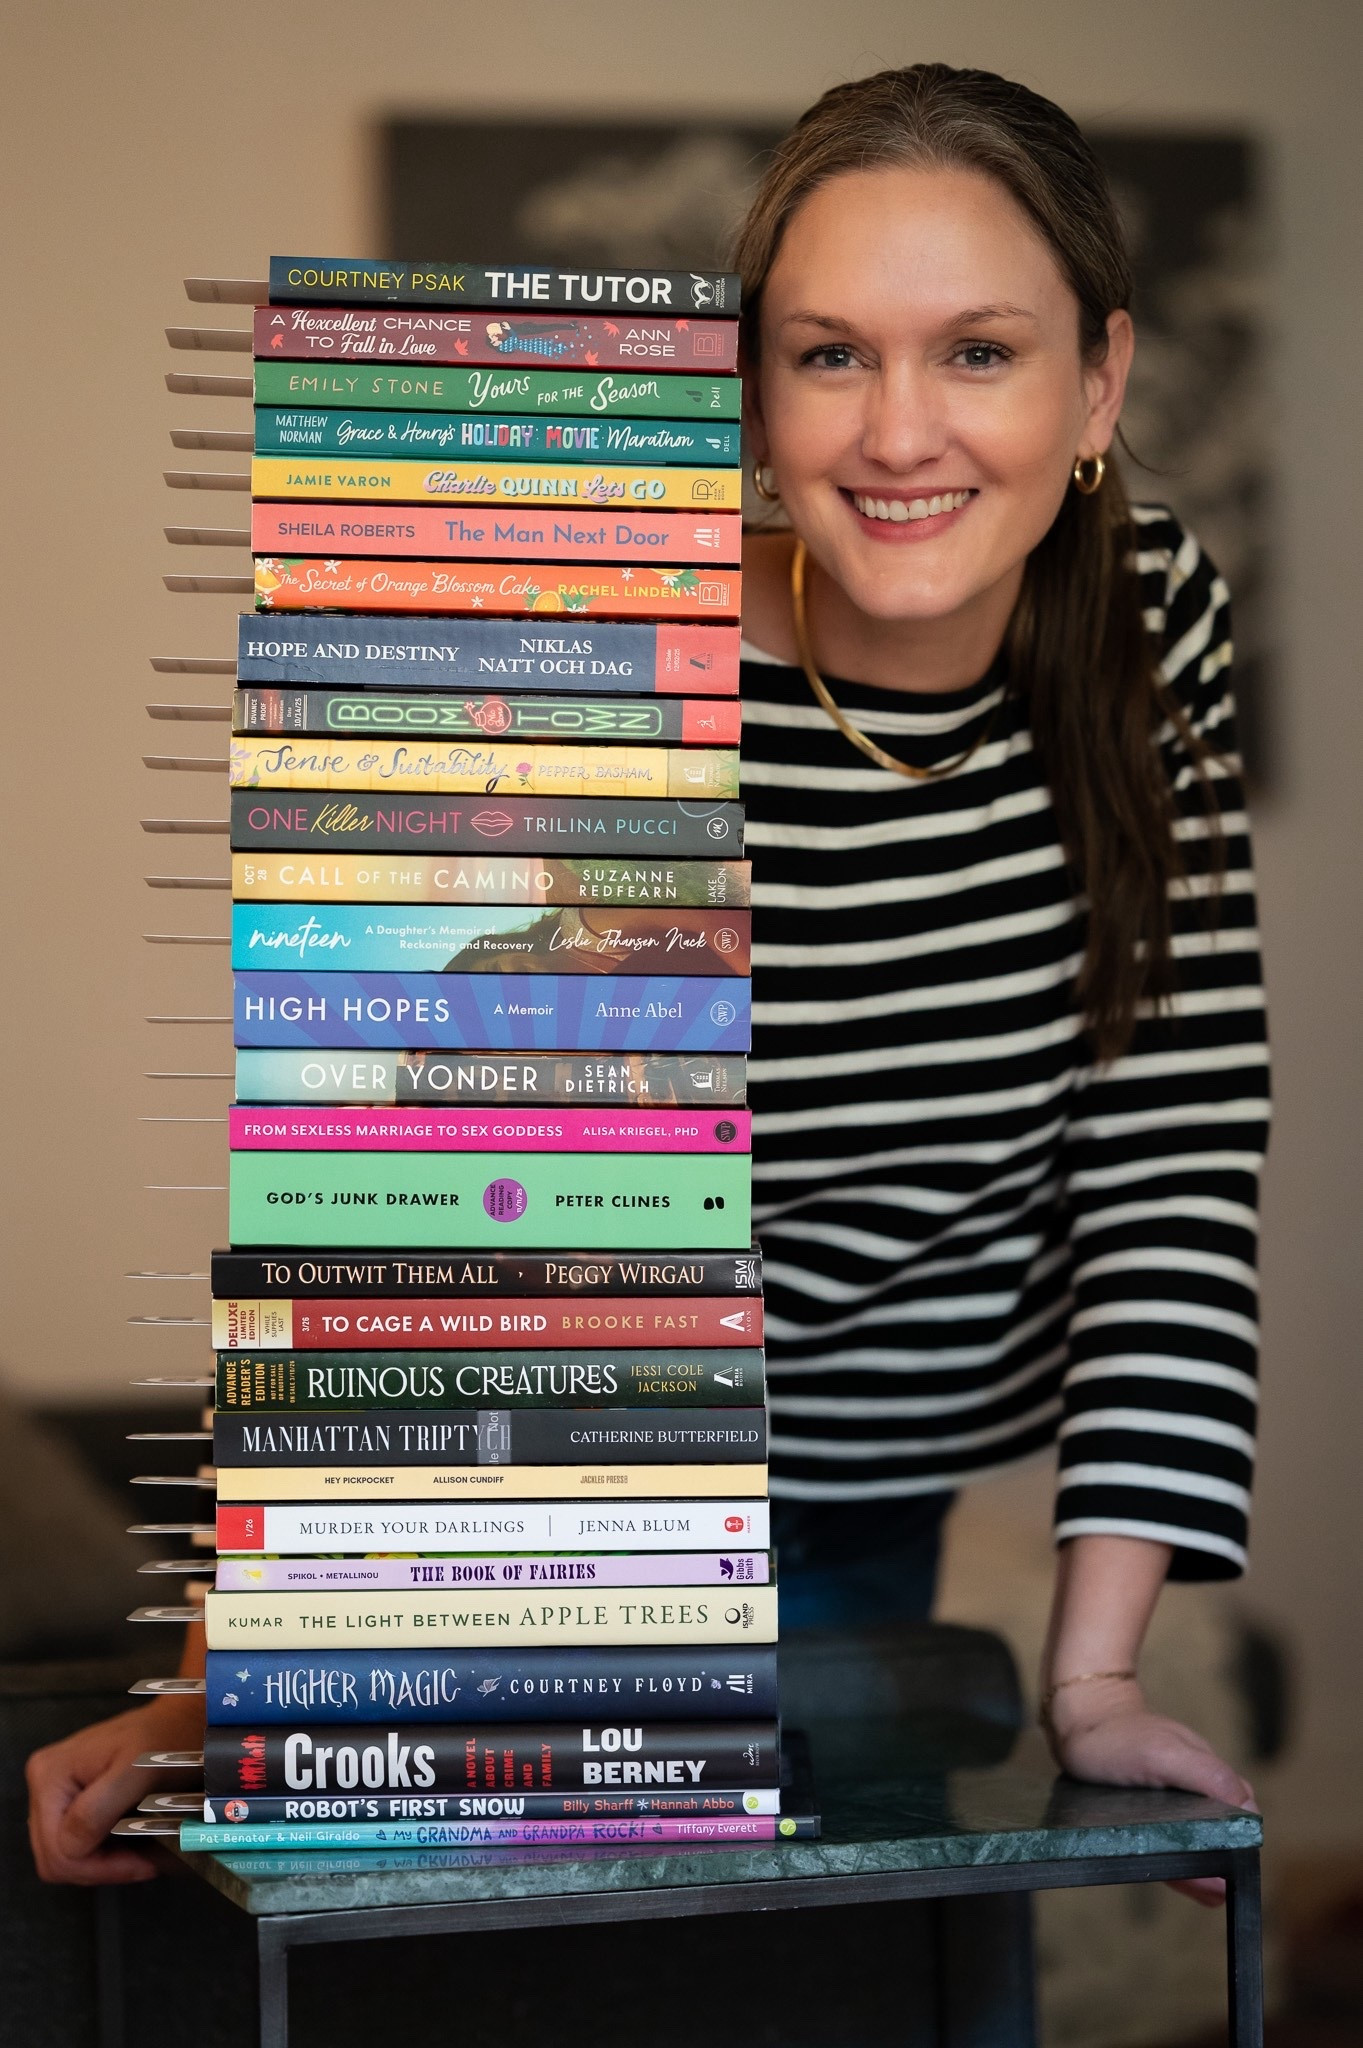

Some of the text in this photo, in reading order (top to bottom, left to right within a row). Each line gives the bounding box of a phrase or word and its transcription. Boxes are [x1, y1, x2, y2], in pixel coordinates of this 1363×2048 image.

[288, 269, 465, 291] COURTNEY PSAK
[485, 272, 672, 304] THE TUTOR
[271, 310, 471, 332] A Hexcellent CHANCE
[306, 333, 437, 355] TO Fall in Love
[626, 329, 671, 341] ANN
[619, 345, 675, 356] ROSE
[290, 376, 443, 395] EMILY STONE
[711, 387, 720, 407] Dell
[276, 415, 328, 427] MATTHEW
[280, 430, 322, 443] NORMAN
[337, 420, 694, 451] Grace & Henry's HOLIDAY MOVIE Marathon
[287, 475, 391, 487] JAMIE VARON
[278, 523, 415, 538] SHEILA ROBERTS
[558, 584, 681, 598] RACHEL LINDEN
[247, 642, 460, 661] HOPE AND DESTINY
[520, 639, 592, 654] NIKLAS
[294, 698, 302, 726] 10/14/25
[538, 765, 652, 780] PEPPER BASHAM
[248, 804, 462, 835] ONE Killer NIGHT
[524, 817, 676, 834] TRILINA PUCCI
[245, 864, 254, 884] OCT
[258, 869, 266, 880] 28
[582, 869, 674, 883] SUZANNE
[580, 885, 677, 898] REDFEARN
[708, 879, 717, 903] LAKE
[717, 868, 727, 903] UNION
[249, 916, 351, 958] nineteen
[366, 925, 496, 936] A Daughter's Memoir of
[721, 932, 733, 949] SWP
[245, 997, 450, 1022] HIGH HOPES
[494, 1004, 553, 1015] A Memoir
[595, 1003, 682, 1018] Anne Abel
[717, 1005, 729, 1023] SWP
[585, 1065, 630, 1077] SEAN
[565, 1080, 649, 1093] DIETRICH
[583, 1127, 698, 1137] ALISA KRIEGEL, PHD
[721, 1123, 730, 1140] SWP
[267, 1193, 459, 1206] GOD'S JUNK DRAWER
[555, 1196, 670, 1207] PETER CLINES
[735, 1261, 747, 1288] ISM
[229, 1302, 238, 1347] DELUXE
[562, 1316, 699, 1329] BROOKE FAST
[631, 1365, 704, 1377] JESSI COLE
[226, 1361, 236, 1404] ADVANCE
[241, 1359, 251, 1406] READER'S
[256, 1364, 265, 1401] EDITION
[308, 1364, 618, 1398] RUINOUS CREATURES
[638, 1381, 697, 1393] JACKSON
[571, 1431, 758, 1443] CATHERINE BUTTERFIELD
[246, 1519, 254, 1537] 1/26
[300, 1520, 524, 1534] MURDER YOUR DARLINGS
[579, 1519, 690, 1535] JENNA BLUM
[229, 1618, 283, 1628] KUMAR
[299, 1605, 708, 1628] THE LIGHT BETWEEN APPLE TREES
[263, 1668, 461, 1710] HIGHER MAGIC
[510, 1677, 702, 1694] COURTNEY FLOYD
[582, 1728, 643, 1752] LOU
[284, 1732, 436, 1790] Crooks
[466, 1738, 476, 1788] A NOVEL
[485, 1749, 494, 1788] ABOUT
[504, 1749, 513, 1787] CRIME
[542, 1744, 551, 1787] FAMILY
[523, 1764, 532, 1787] AND
[583, 1760, 706, 1784] BERNEY
[286, 1798, 525, 1819] ROBOT'S FIRST SNOW
[200, 1831, 360, 1844] Pat Benatar & Neil Giraldo
[677, 1823, 757, 1835] Tiffany Everett
